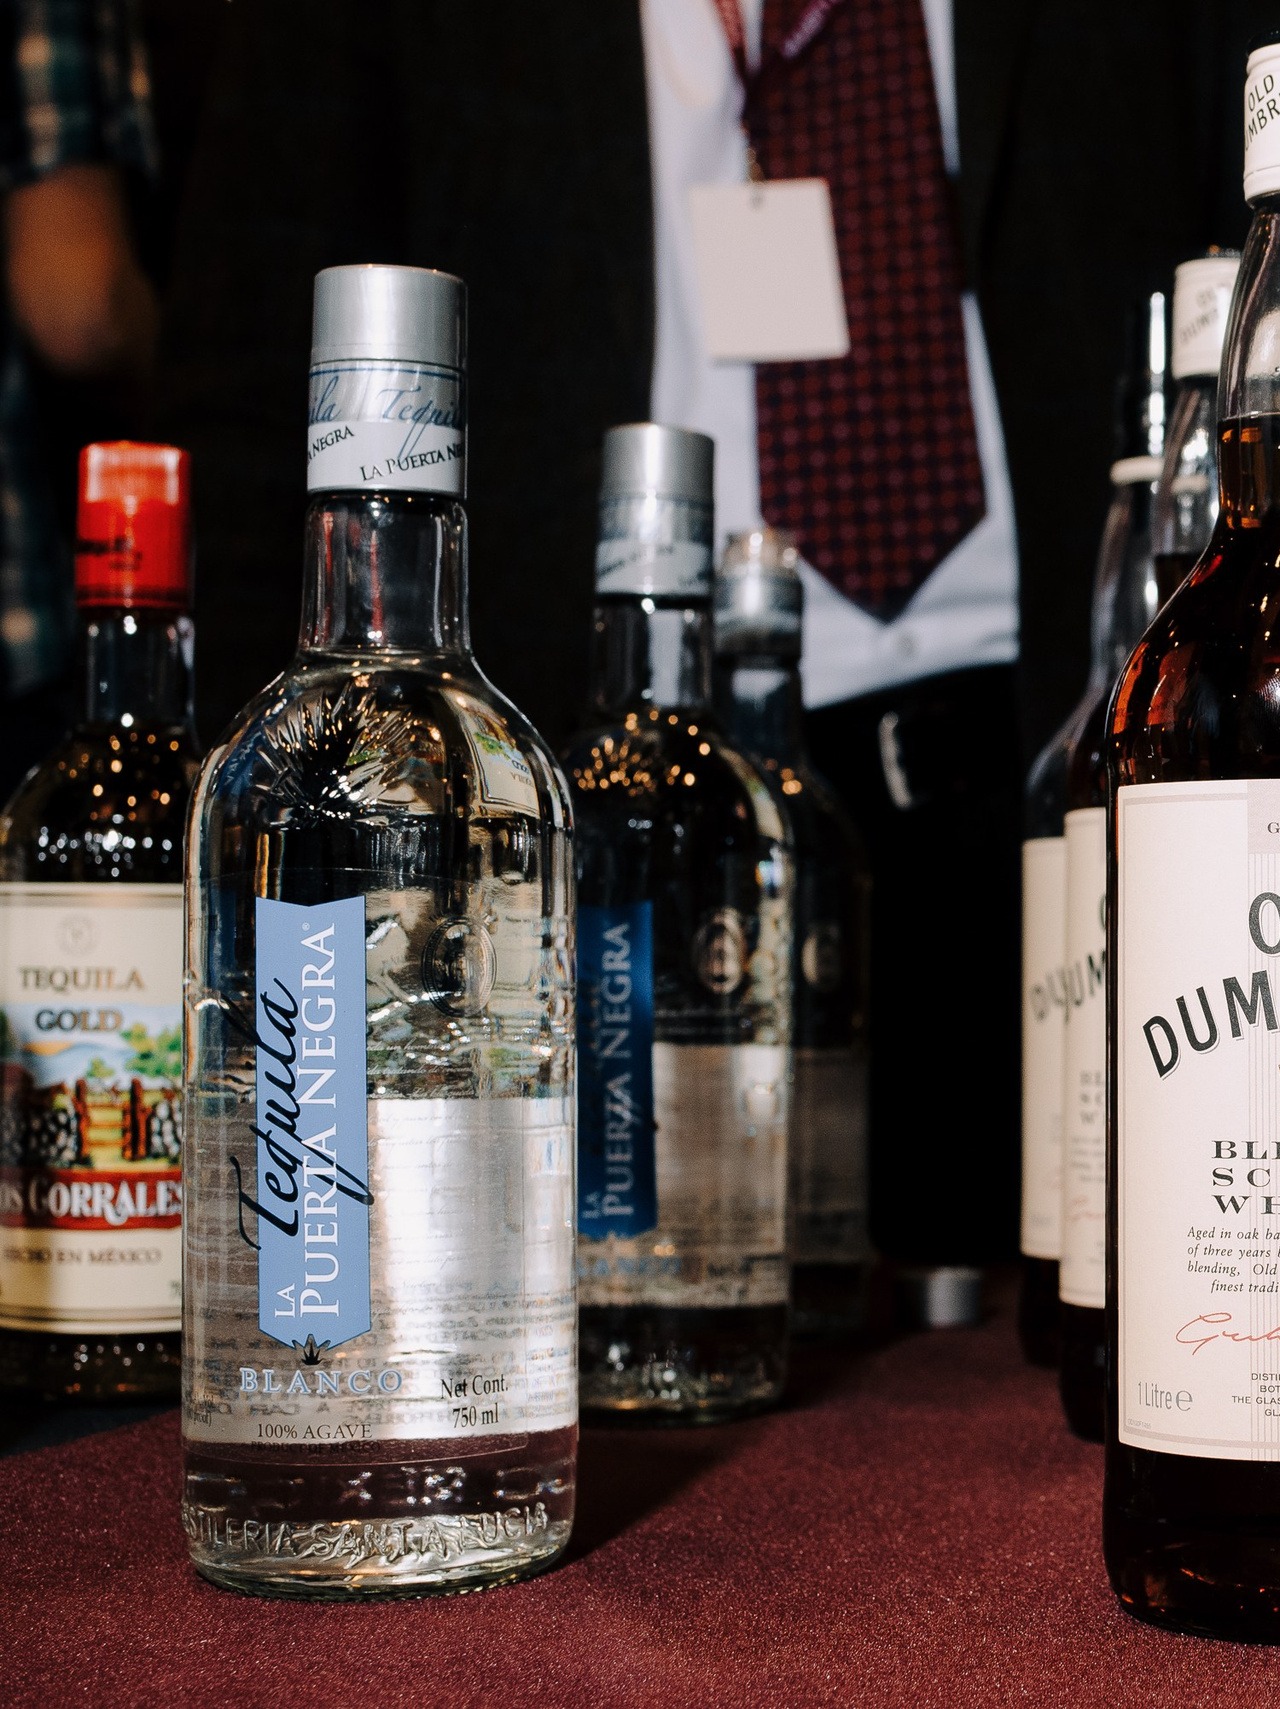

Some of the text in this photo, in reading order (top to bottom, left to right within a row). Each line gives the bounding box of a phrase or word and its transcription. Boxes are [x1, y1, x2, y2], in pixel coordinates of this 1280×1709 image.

[1247, 73, 1275, 113] OLD
[359, 465, 383, 481] LA
[386, 448, 446, 475] PUERTA
[18, 966, 146, 994] TEQUILA
[599, 922, 632, 1058] NEGRA
[35, 1008, 123, 1032] GOLD
[219, 977, 375, 1250] Tequila
[300, 1122, 340, 1317] PUERTA
[1187, 1226, 1215, 1240] Aged
[1220, 1228, 1232, 1239] in
[1237, 1228, 1259, 1240] oak
[1187, 1243, 1200, 1258] of
[1203, 1244, 1233, 1256] three
[1239, 1248, 1271, 1260] years
[1187, 1260, 1240, 1277] blending,
[1252, 1263, 1278, 1275] Old
[1210, 1279, 1244, 1293] finest
[274, 1282, 296, 1319] LA
[239, 1367, 402, 1394] BLANCO
[441, 1374, 508, 1399] Net Cont.
[1138, 1381, 1141, 1405] 1
[1145, 1382, 1172, 1409] Litre
[1232, 1395, 1251, 1404] THE
[453, 1405, 477, 1428] 750
[481, 1402, 499, 1425] ml
[258, 1423, 373, 1439] 100% AGAVE
